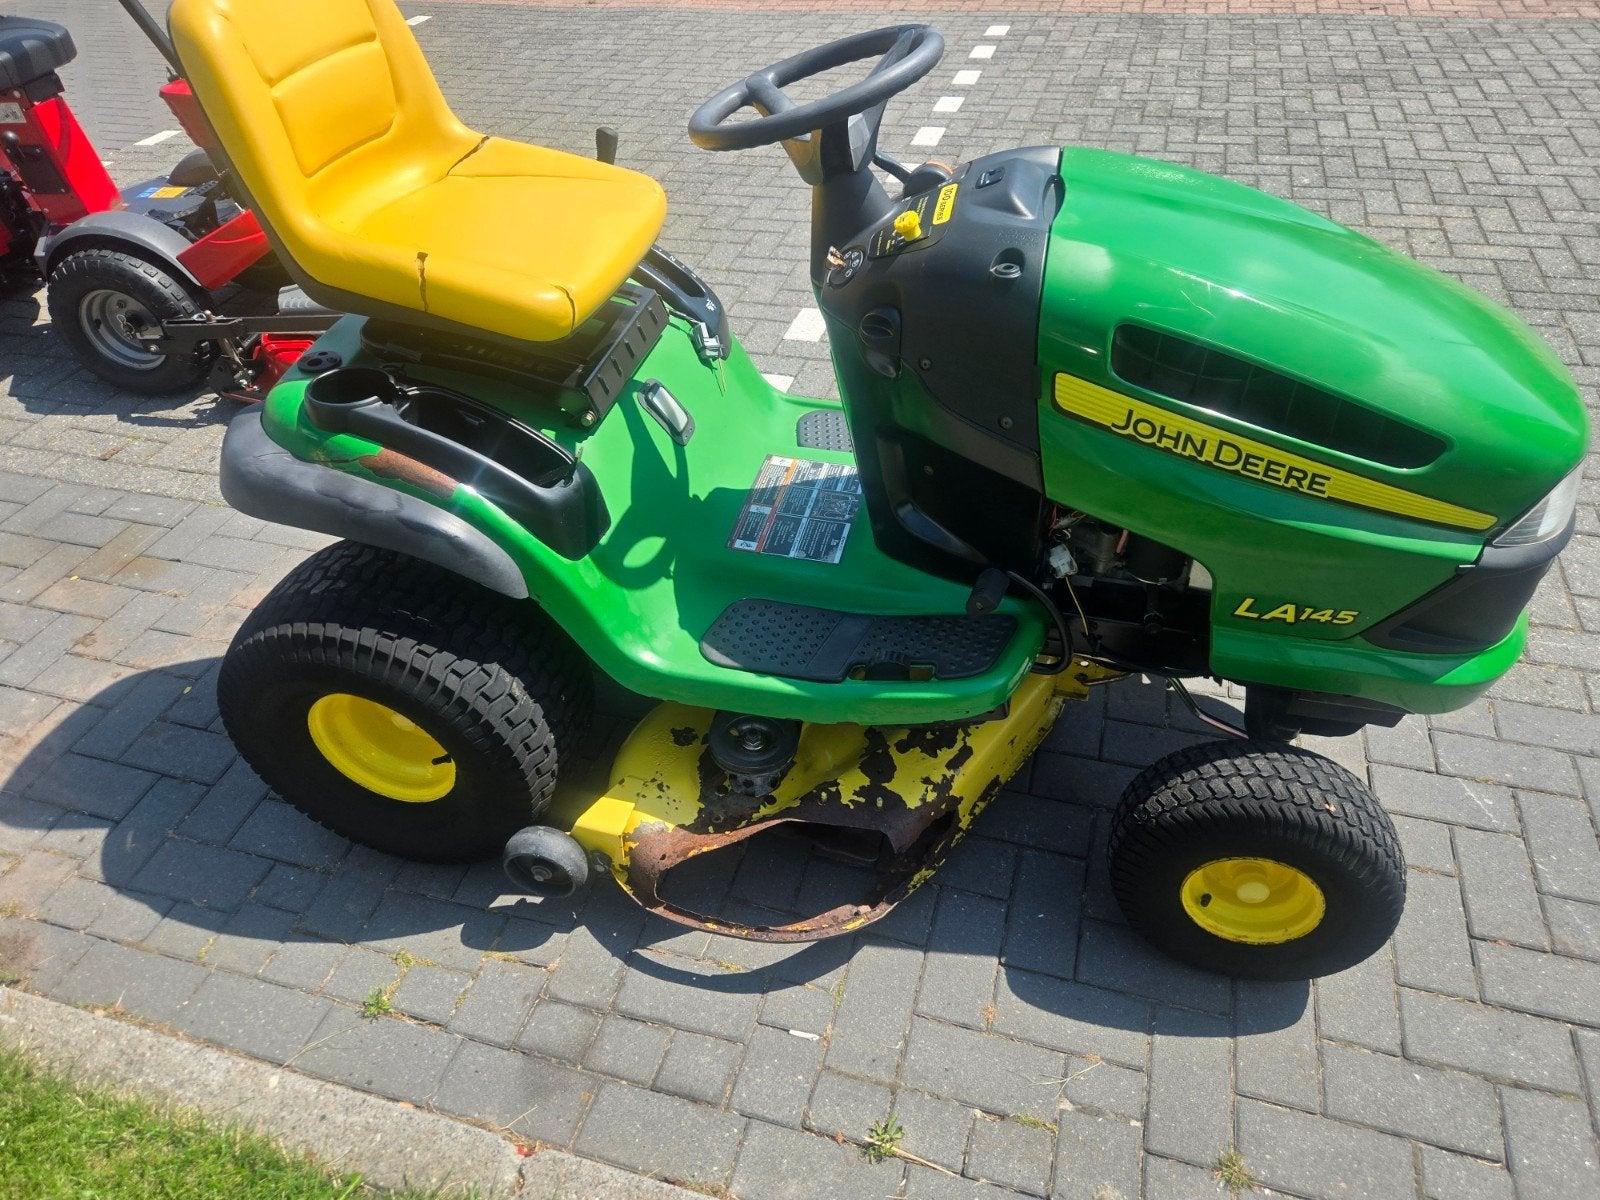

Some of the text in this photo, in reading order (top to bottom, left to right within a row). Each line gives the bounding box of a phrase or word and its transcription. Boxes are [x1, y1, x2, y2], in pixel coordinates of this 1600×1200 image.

[942, 187, 954, 201] 100
[936, 201, 947, 221] SERIES
[1111, 409, 1331, 495] JOHN DEERE
[1233, 597, 1360, 625] LA145
